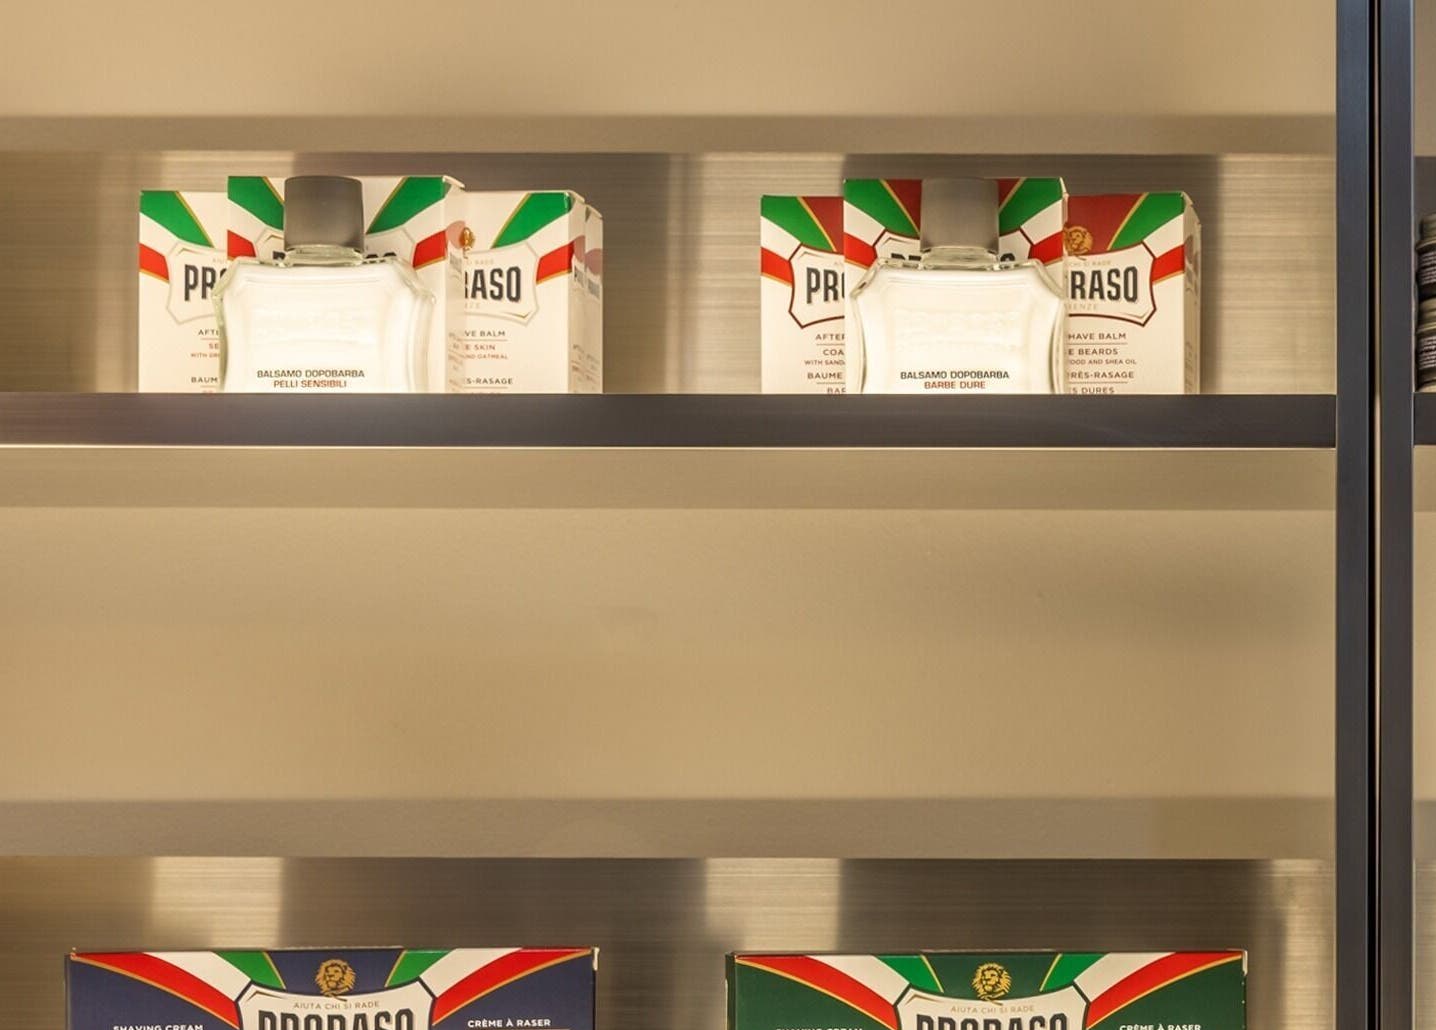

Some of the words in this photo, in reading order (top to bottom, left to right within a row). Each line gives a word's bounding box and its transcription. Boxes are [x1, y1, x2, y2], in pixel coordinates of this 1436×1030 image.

[257, 370, 302, 378] BALSAMO
[305, 369, 365, 377] DOPOBARBA
[900, 371, 947, 380] BALSAMO
[950, 371, 1009, 379] DOPOBARBA
[274, 380, 297, 388] PELLI
[301, 380, 347, 388] SENSIBILI
[468, 1018, 503, 1028] CRÈME
[506, 1018, 513, 1027] À
[516, 1018, 550, 1027] RASER
